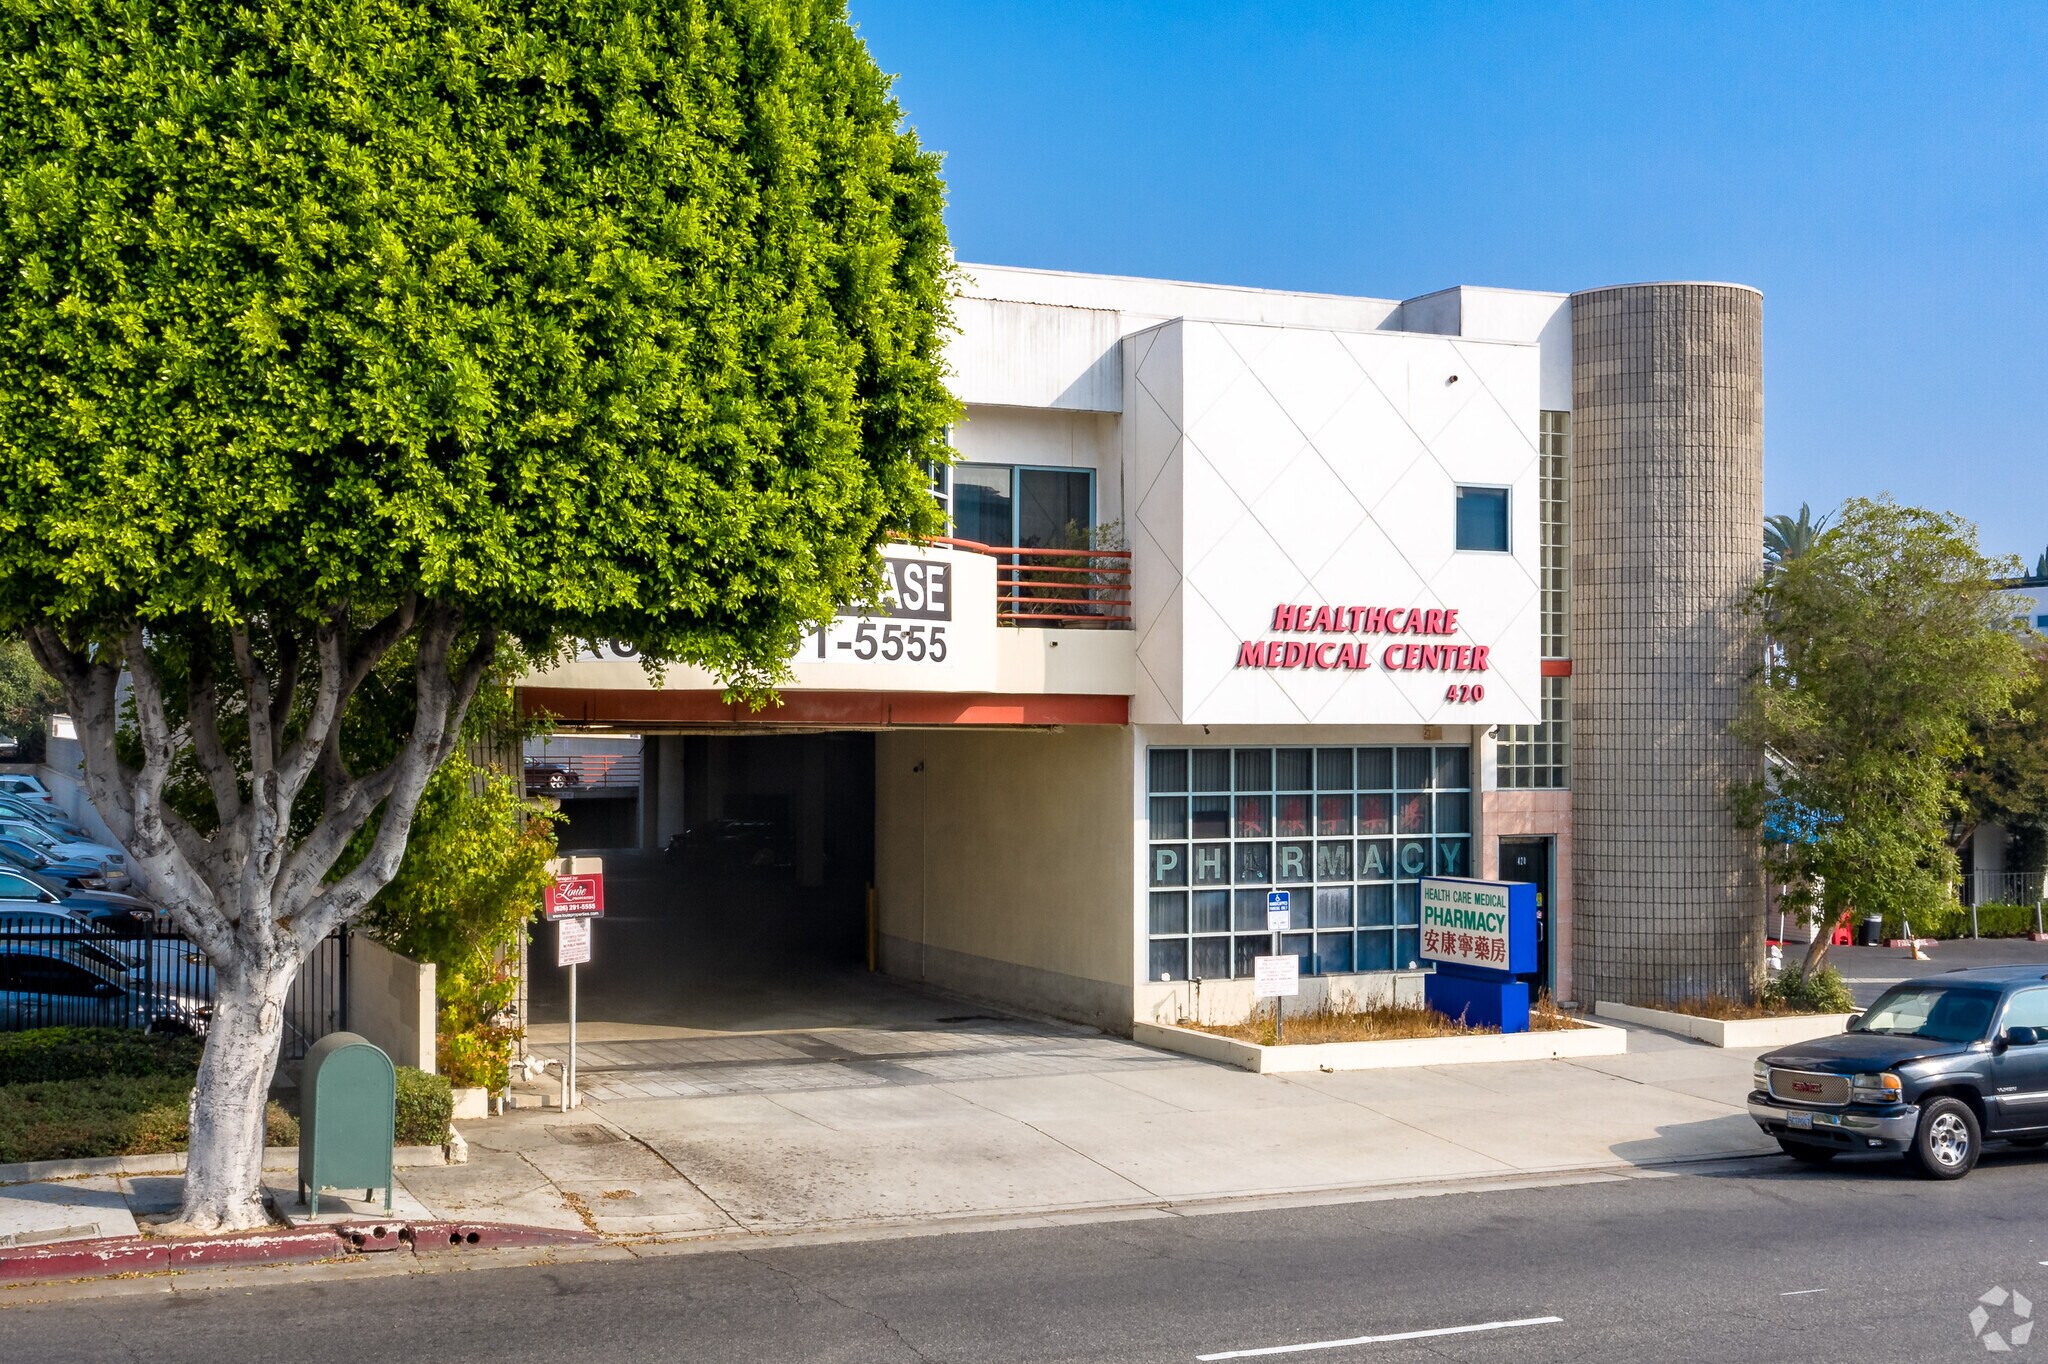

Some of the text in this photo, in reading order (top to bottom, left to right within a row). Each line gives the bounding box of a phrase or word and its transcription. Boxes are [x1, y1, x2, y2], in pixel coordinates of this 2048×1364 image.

[1273, 603, 1459, 635] HEALTHCARE
[1236, 640, 1490, 672] MEDICAL CENTER
[1446, 684, 1486, 703] 420
[1156, 842, 1461, 881] PHARMACY
[556, 882, 587, 901] Louie
[1424, 887, 1507, 908] HEALTH CARE MEDICAL
[1424, 905, 1506, 934] PHARMACY
